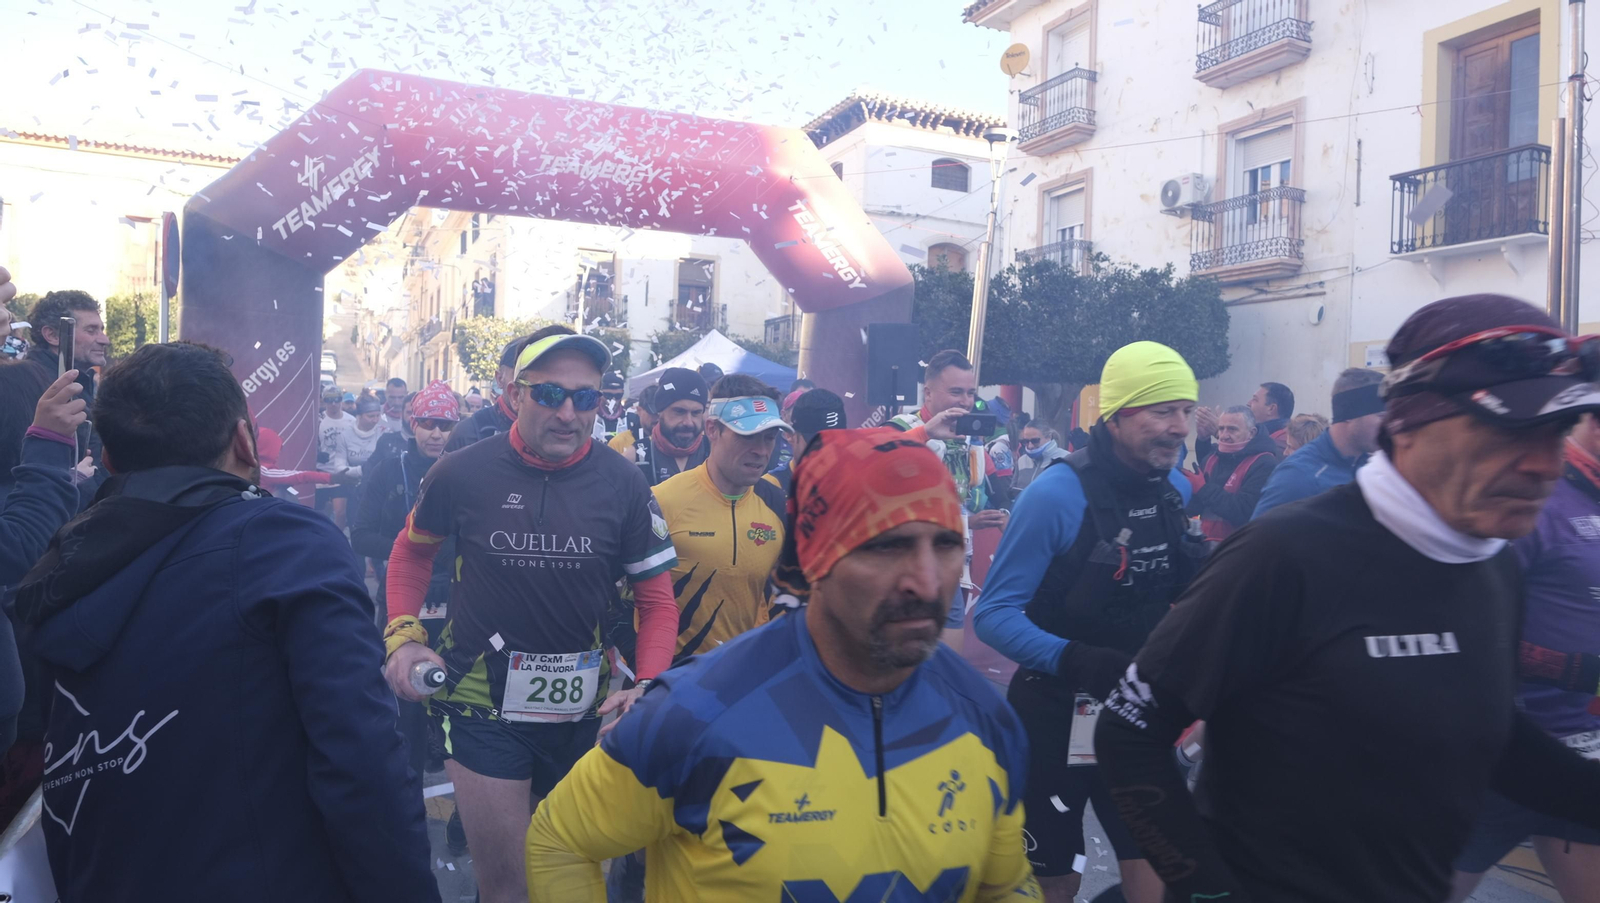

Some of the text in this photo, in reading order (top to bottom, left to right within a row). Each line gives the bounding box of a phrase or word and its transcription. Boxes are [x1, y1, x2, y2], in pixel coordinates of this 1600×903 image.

[539, 154, 663, 184] TEAMERGY
[272, 145, 381, 240] TEAMERGY
[788, 199, 867, 289] TEAMERGY
[489, 530, 594, 554] CUELLAR
[502, 559, 546, 568] STONE
[1363, 631, 1461, 658] ULTRA
[520, 663, 574, 673] LA PÓLVORA
[526, 654, 538, 662] IV
[540, 655, 563, 663] CxM
[526, 676, 583, 704] 288
[44, 709, 179, 774] ens
[44, 757, 124, 791] EVENTOS NON STOP
[768, 809, 837, 823] TEAMERGY
